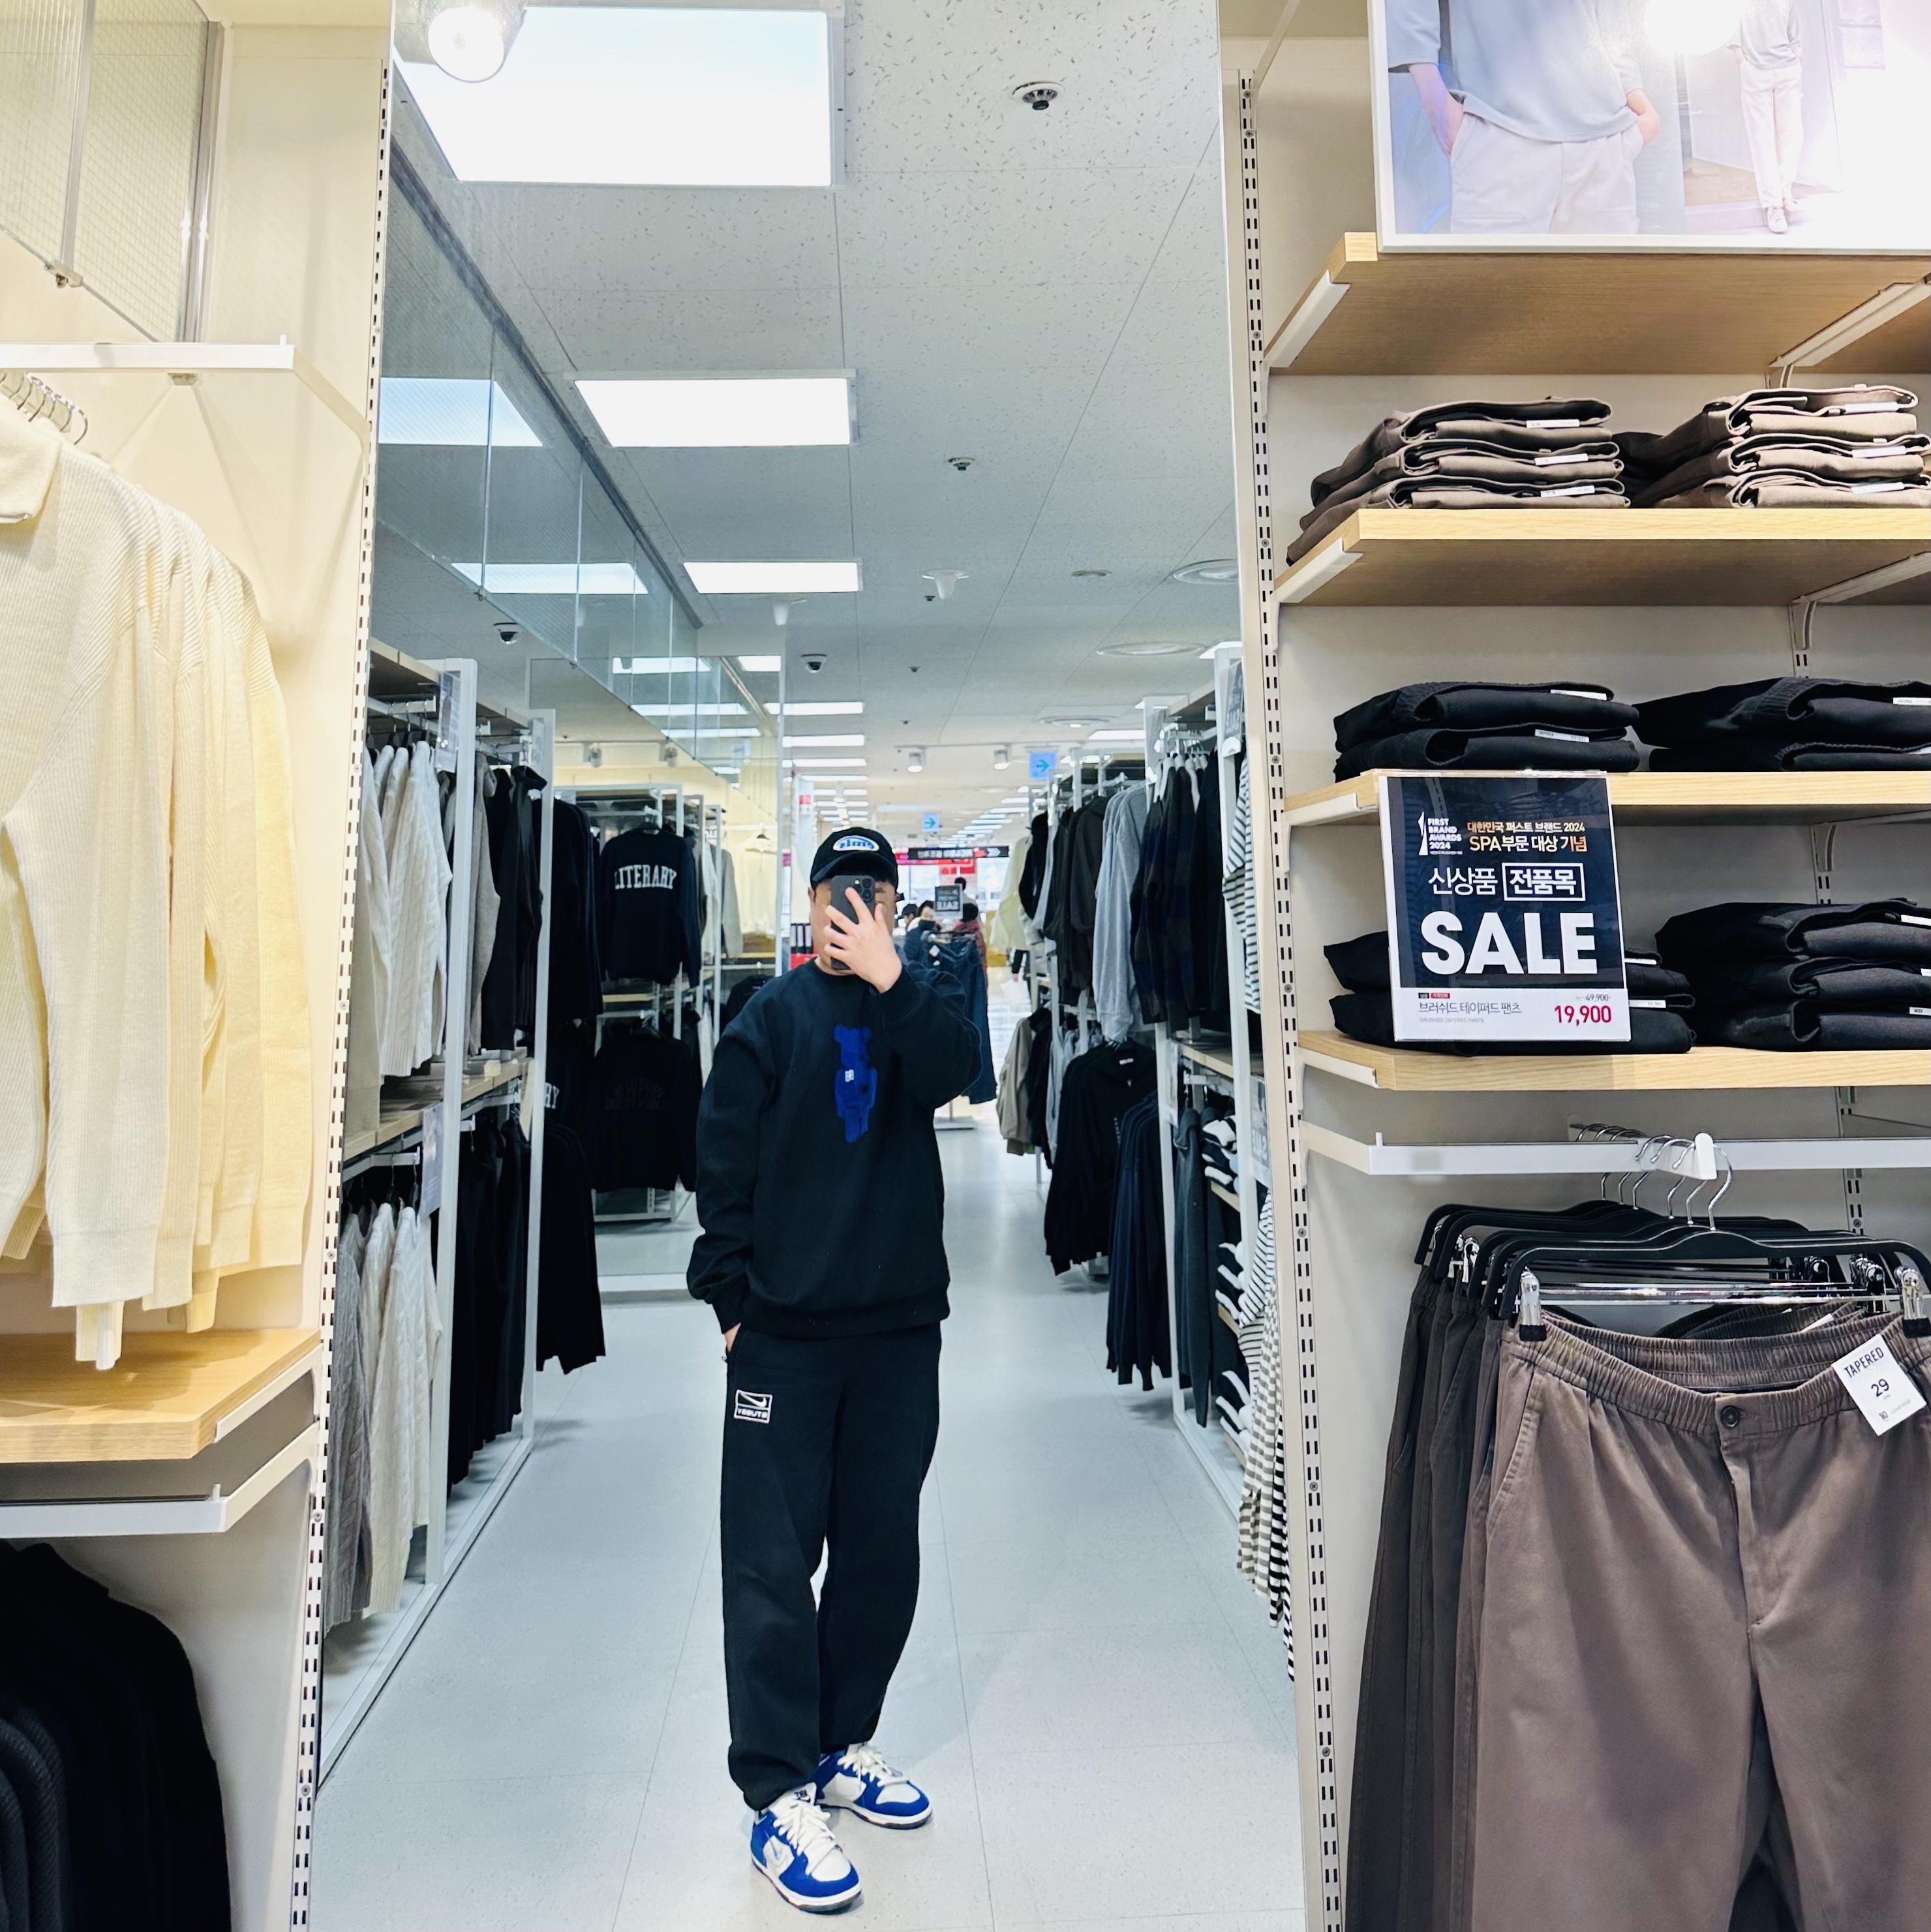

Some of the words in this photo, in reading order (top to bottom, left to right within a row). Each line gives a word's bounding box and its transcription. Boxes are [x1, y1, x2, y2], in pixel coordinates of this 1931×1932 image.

[1427, 818, 1449, 826] FIRST
[1467, 821, 1504, 833] 대한민국
[1506, 821, 1533, 833] 퍼스트
[1535, 821, 1562, 833] 브랜드
[1563, 823, 1585, 833] 2024
[1531, 835, 1558, 852] 대상
[1560, 835, 1587, 852] 기념
[614, 864, 677, 890] LITERARY
[1428, 867, 1498, 896] 신상품
[1509, 868, 1577, 895] 전품목
[1421, 910, 1598, 975] SALE
[1585, 994, 1609, 1002] 49,900
[1418, 1002, 1459, 1014] 브러쉬드
[1459, 1002, 1500, 1014] 테이퍼드
[1501, 1002, 1522, 1015] 팬츠
[1555, 1005, 1612, 1026] 19,900
[1844, 1347, 1884, 1378] TAPERED
[1870, 1378, 1889, 1397] 29
